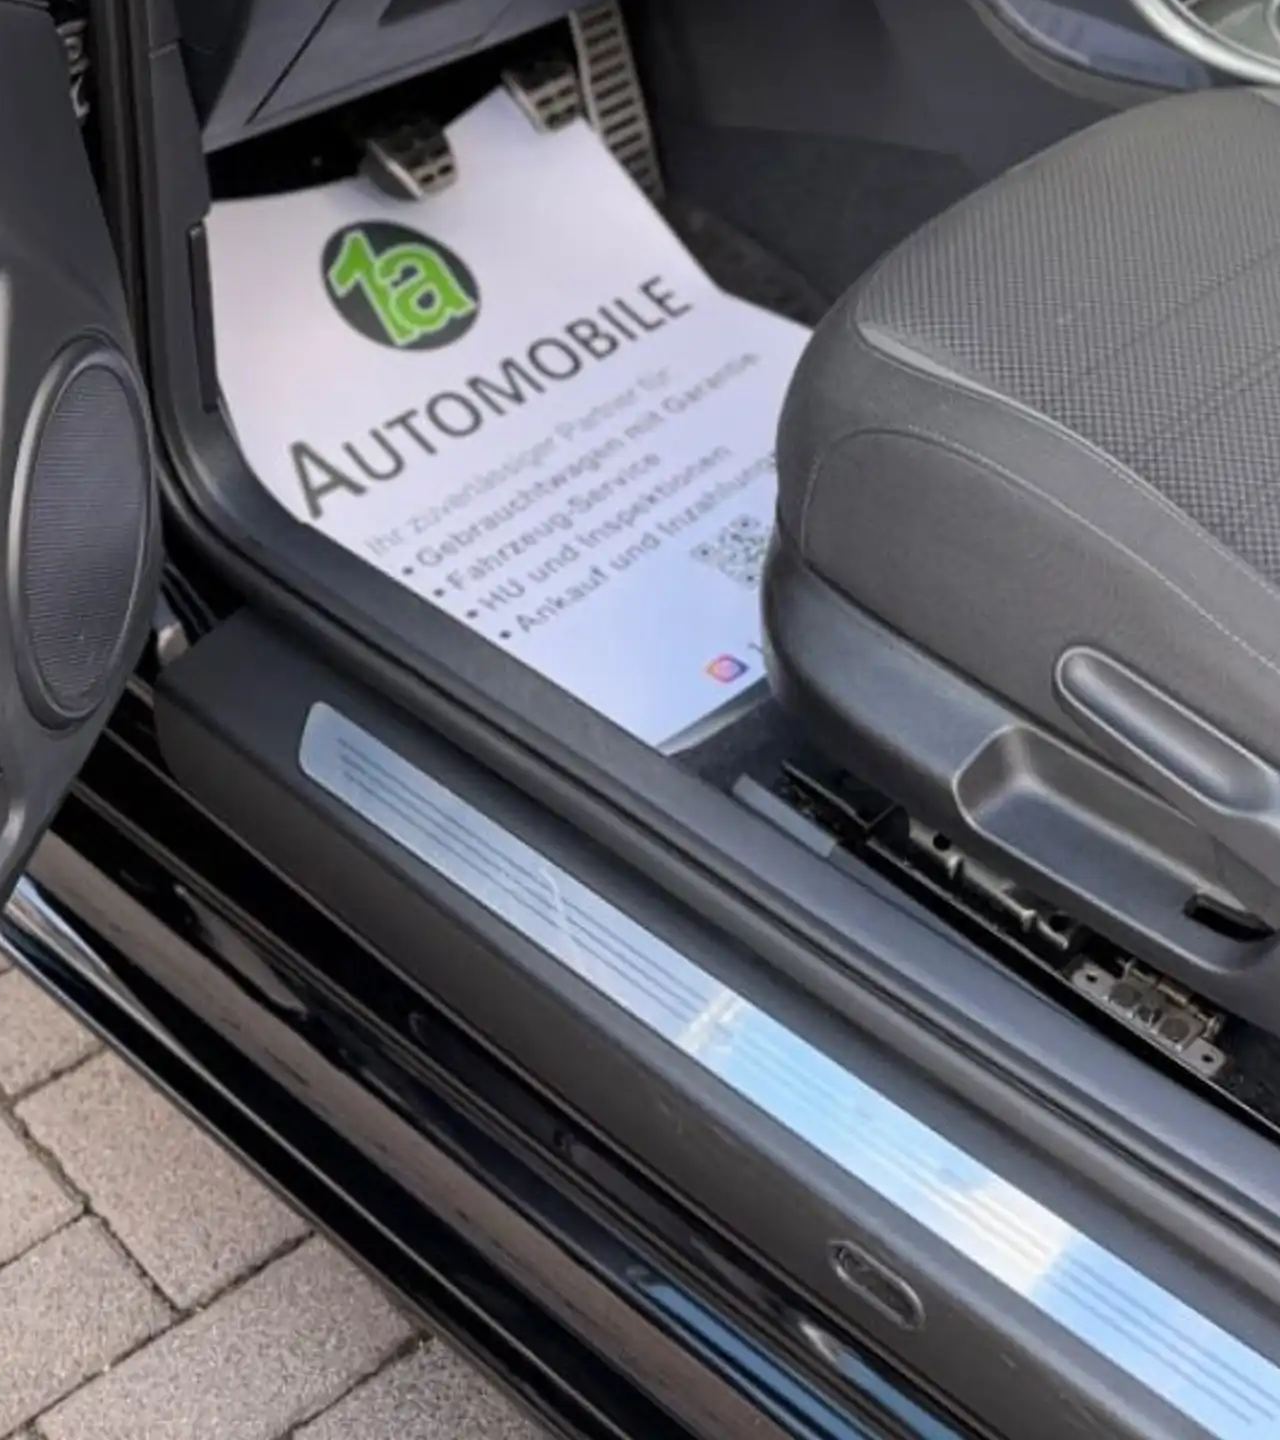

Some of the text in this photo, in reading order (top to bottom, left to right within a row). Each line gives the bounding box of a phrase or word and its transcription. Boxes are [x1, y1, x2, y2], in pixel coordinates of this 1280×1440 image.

[328, 229, 477, 346] 1a
[289, 274, 693, 520] AUTOMOBILE
[415, 436, 625, 568] Gebrauchtwagen
[445, 452, 661, 591] Fahrzeug-Service
[477, 576, 526, 613] HU
[527, 541, 581, 584] und
[515, 563, 610, 634] Ankauf
[609, 530, 662, 572] und
